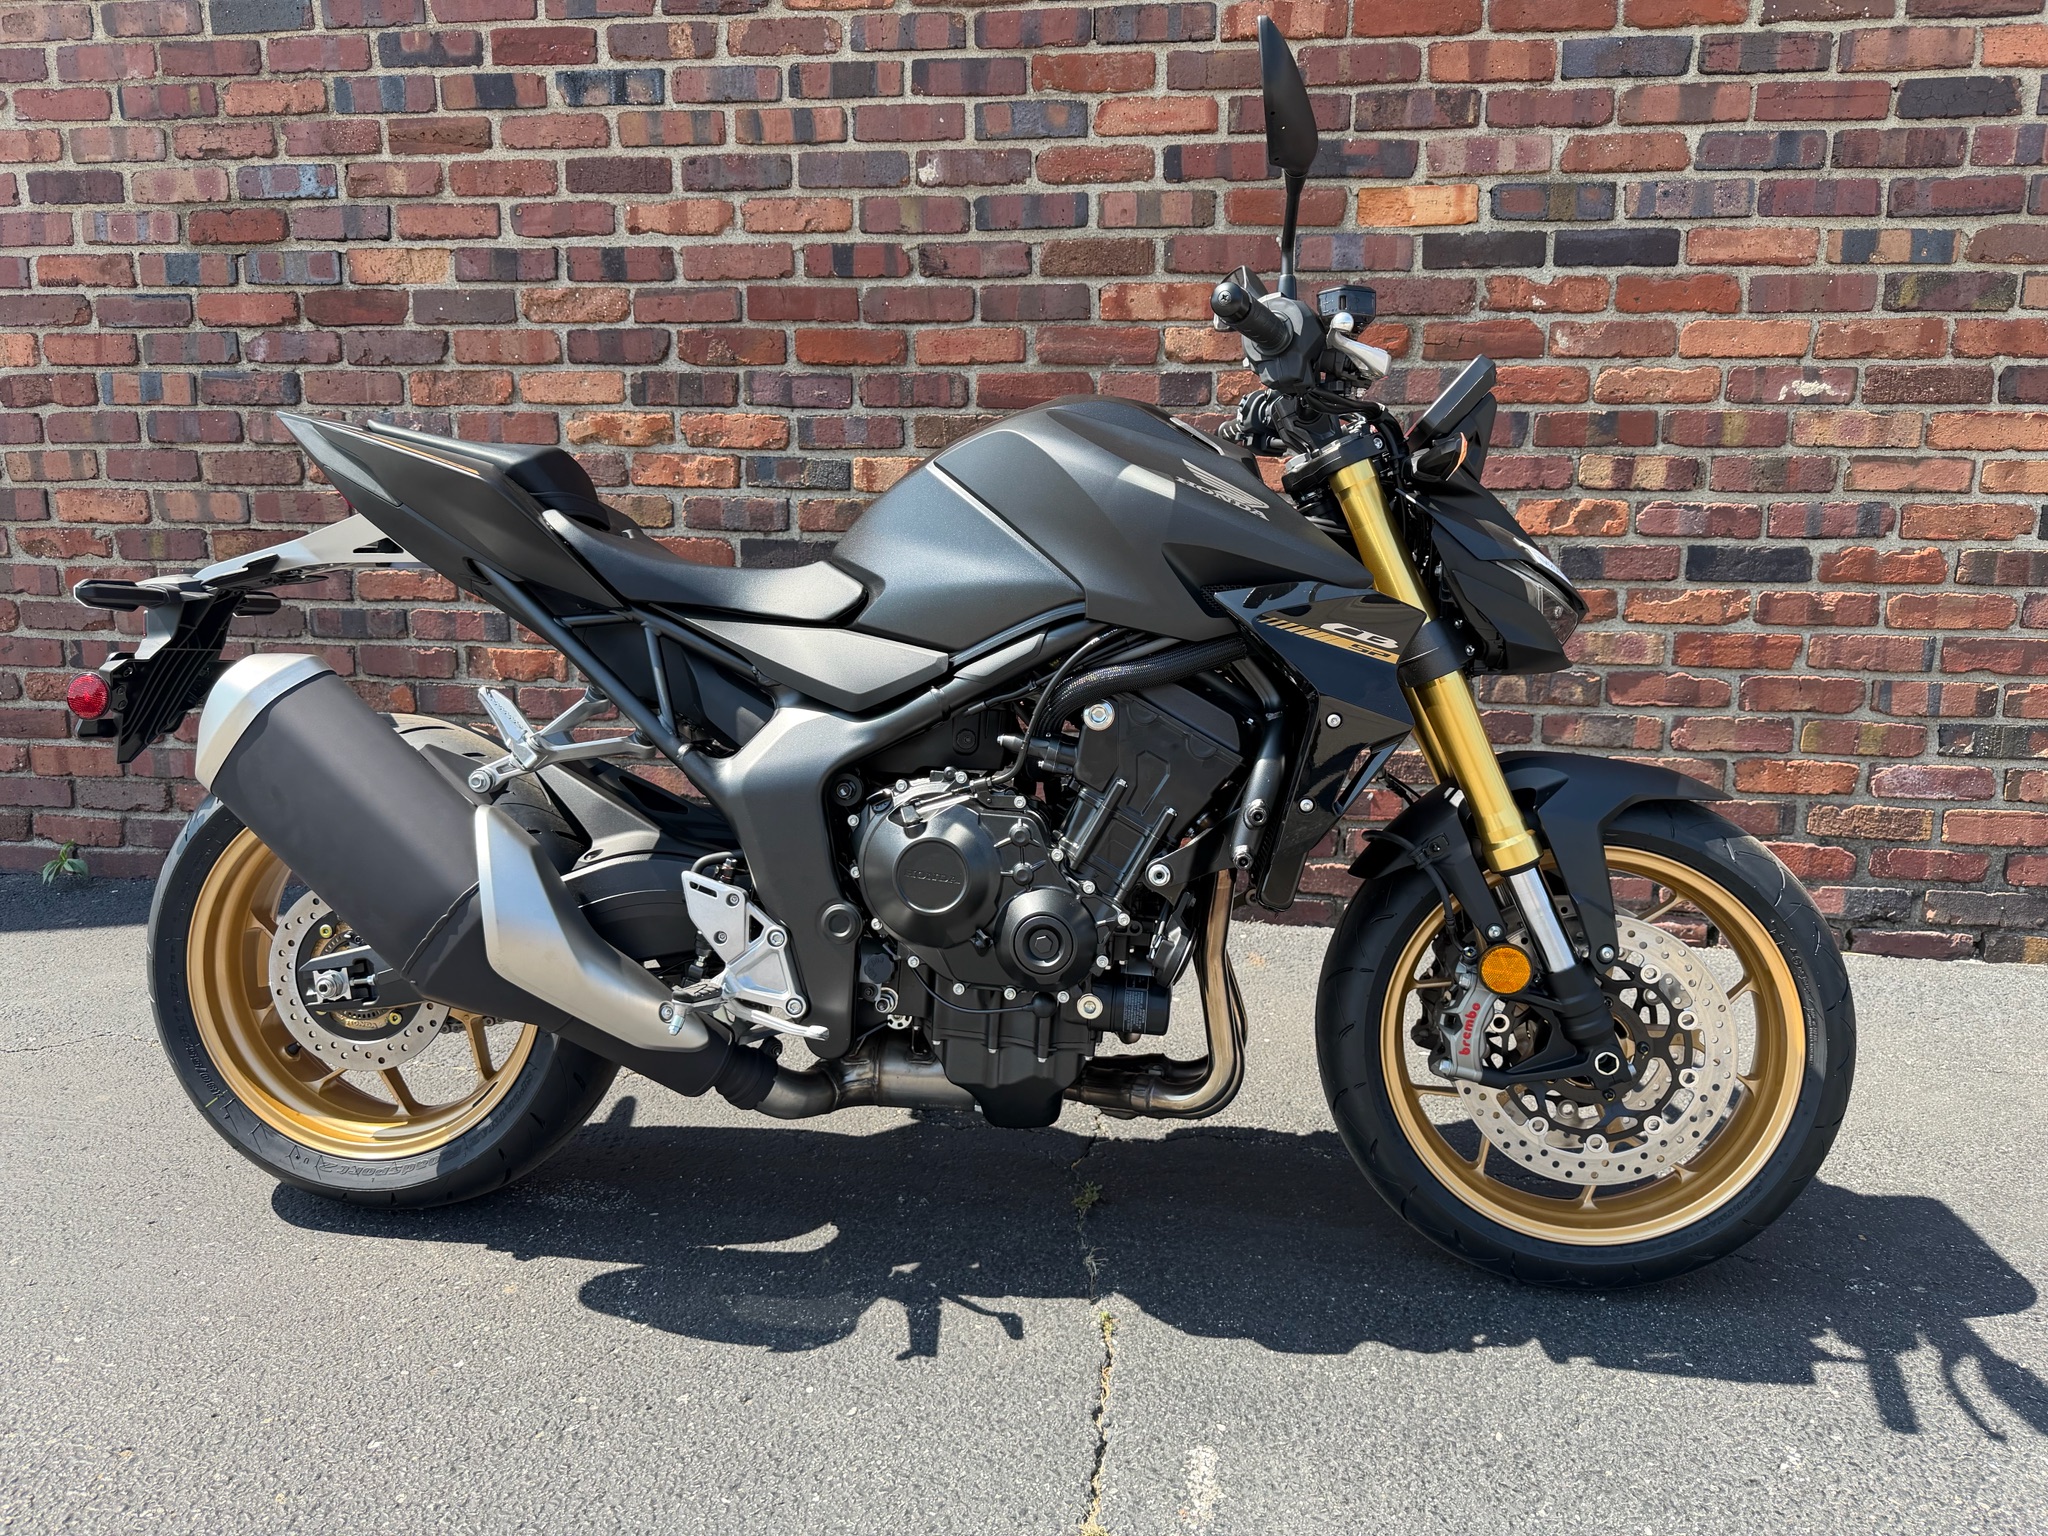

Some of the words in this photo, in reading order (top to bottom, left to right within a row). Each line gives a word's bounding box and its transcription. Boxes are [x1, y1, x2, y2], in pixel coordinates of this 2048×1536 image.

[1175, 475, 1270, 522] HONDA
[1320, 622, 1399, 649] CB
[1349, 643, 1391, 658] SP
[903, 868, 961, 885] HONDA
[1458, 1002, 1481, 1056] brembo
